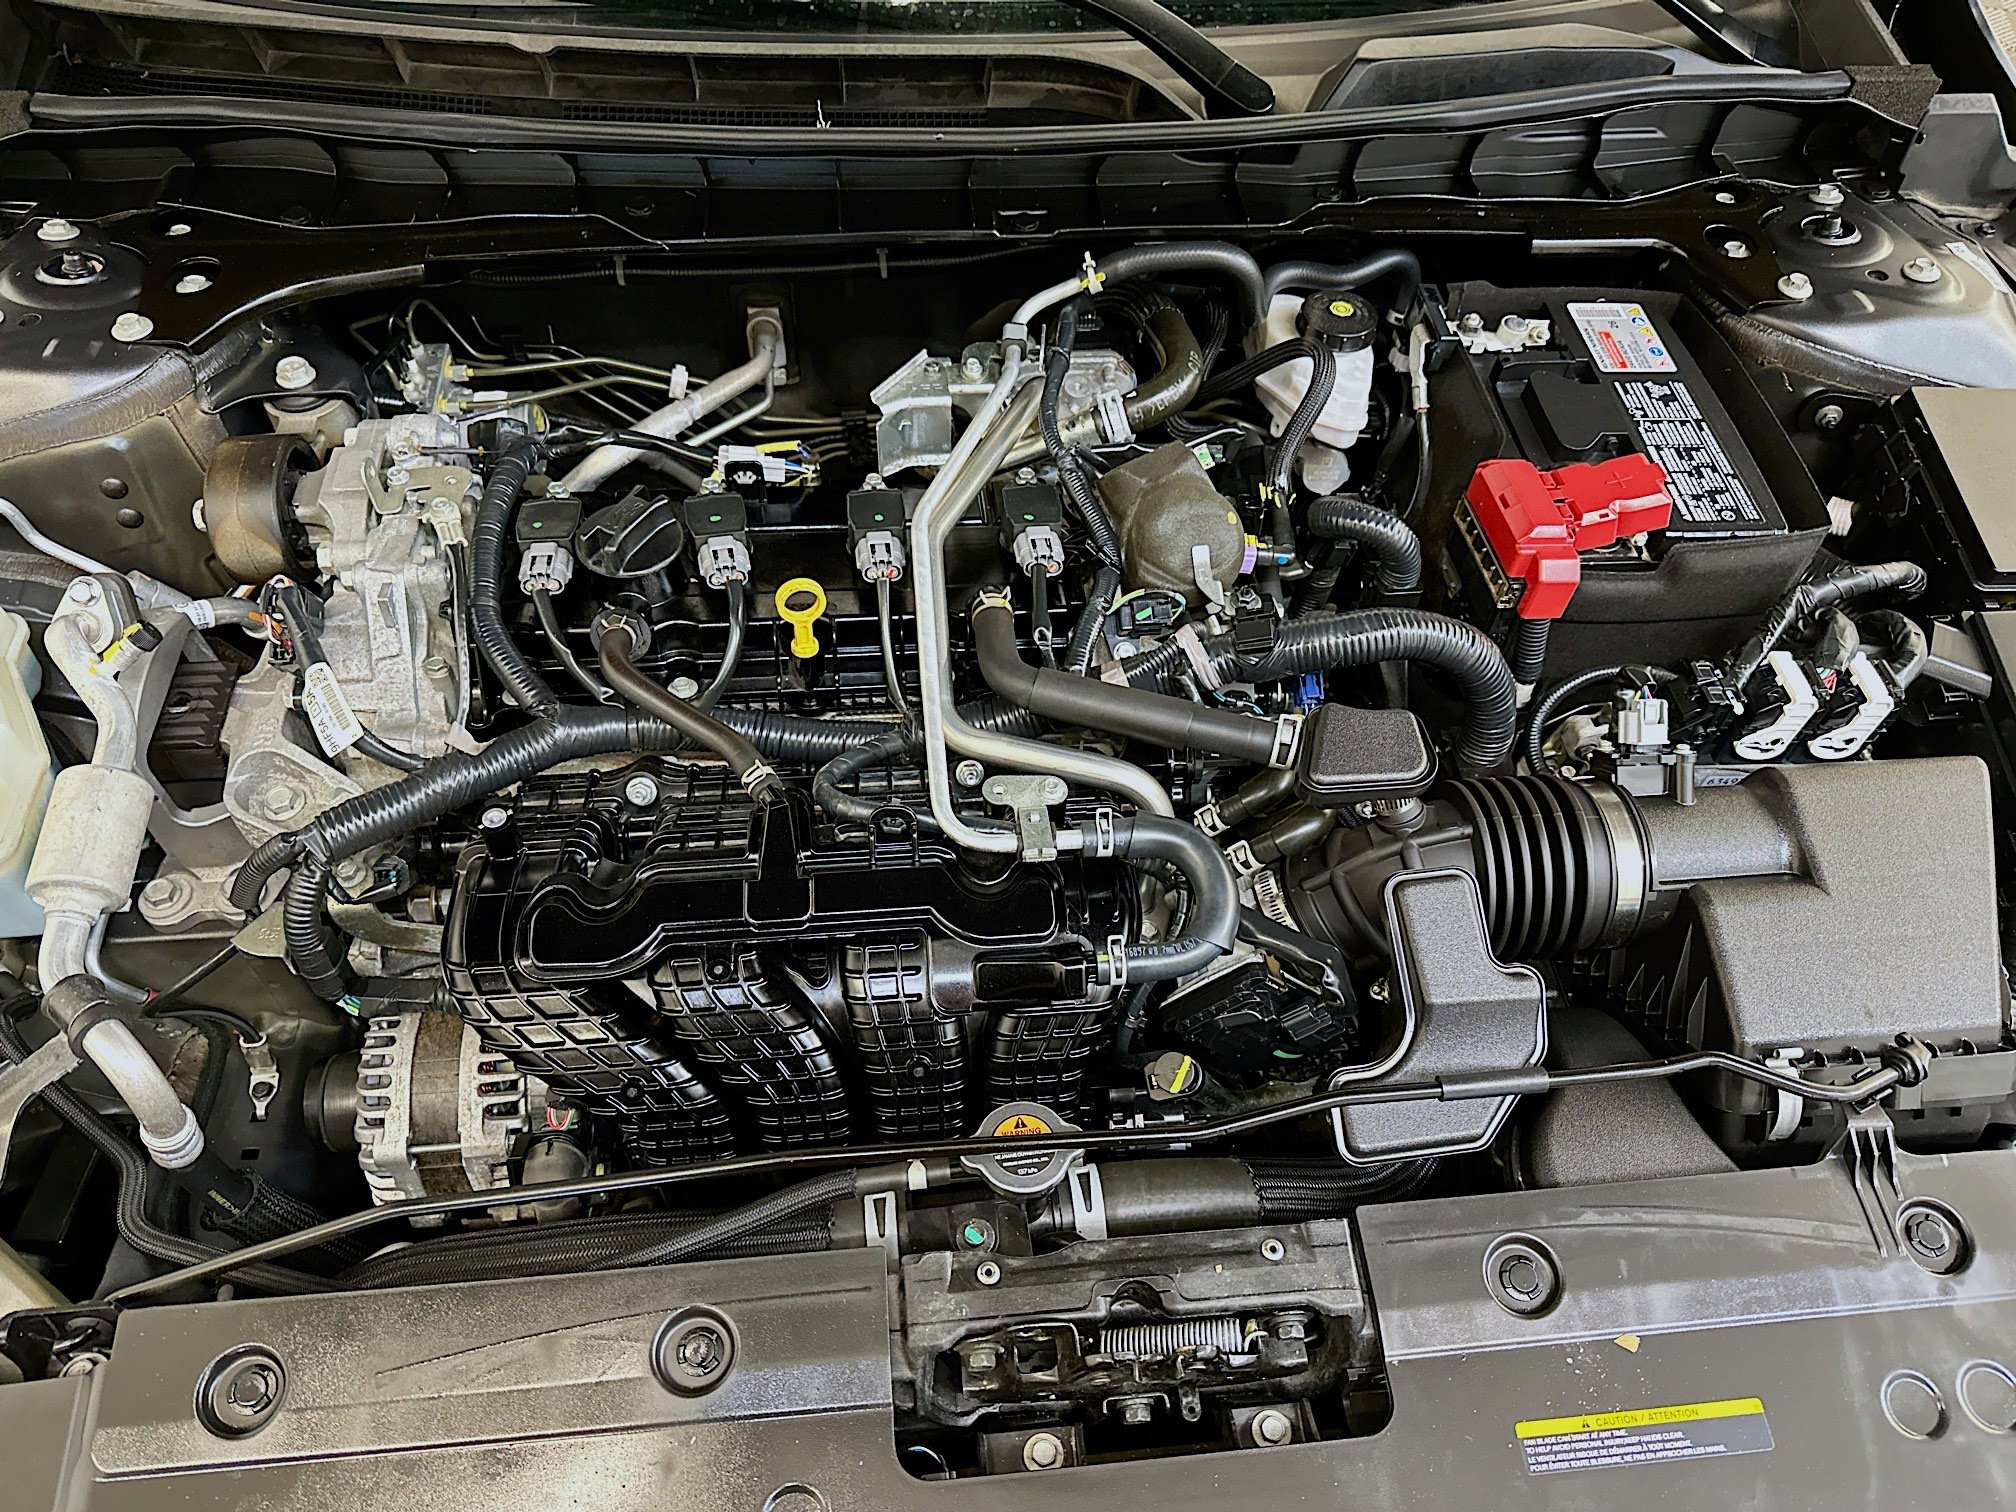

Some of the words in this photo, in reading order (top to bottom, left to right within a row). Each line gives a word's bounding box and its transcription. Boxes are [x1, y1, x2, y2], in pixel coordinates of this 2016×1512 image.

[1596, 1414, 1638, 1427] CAUTION
[1648, 1409, 1699, 1422] ATTENTION
[1536, 1436, 1557, 1444] BLADE
[1525, 1446, 1535, 1454] TO
[1534, 1445, 1552, 1453] HELP
[1529, 1463, 1548, 1471] POUR
